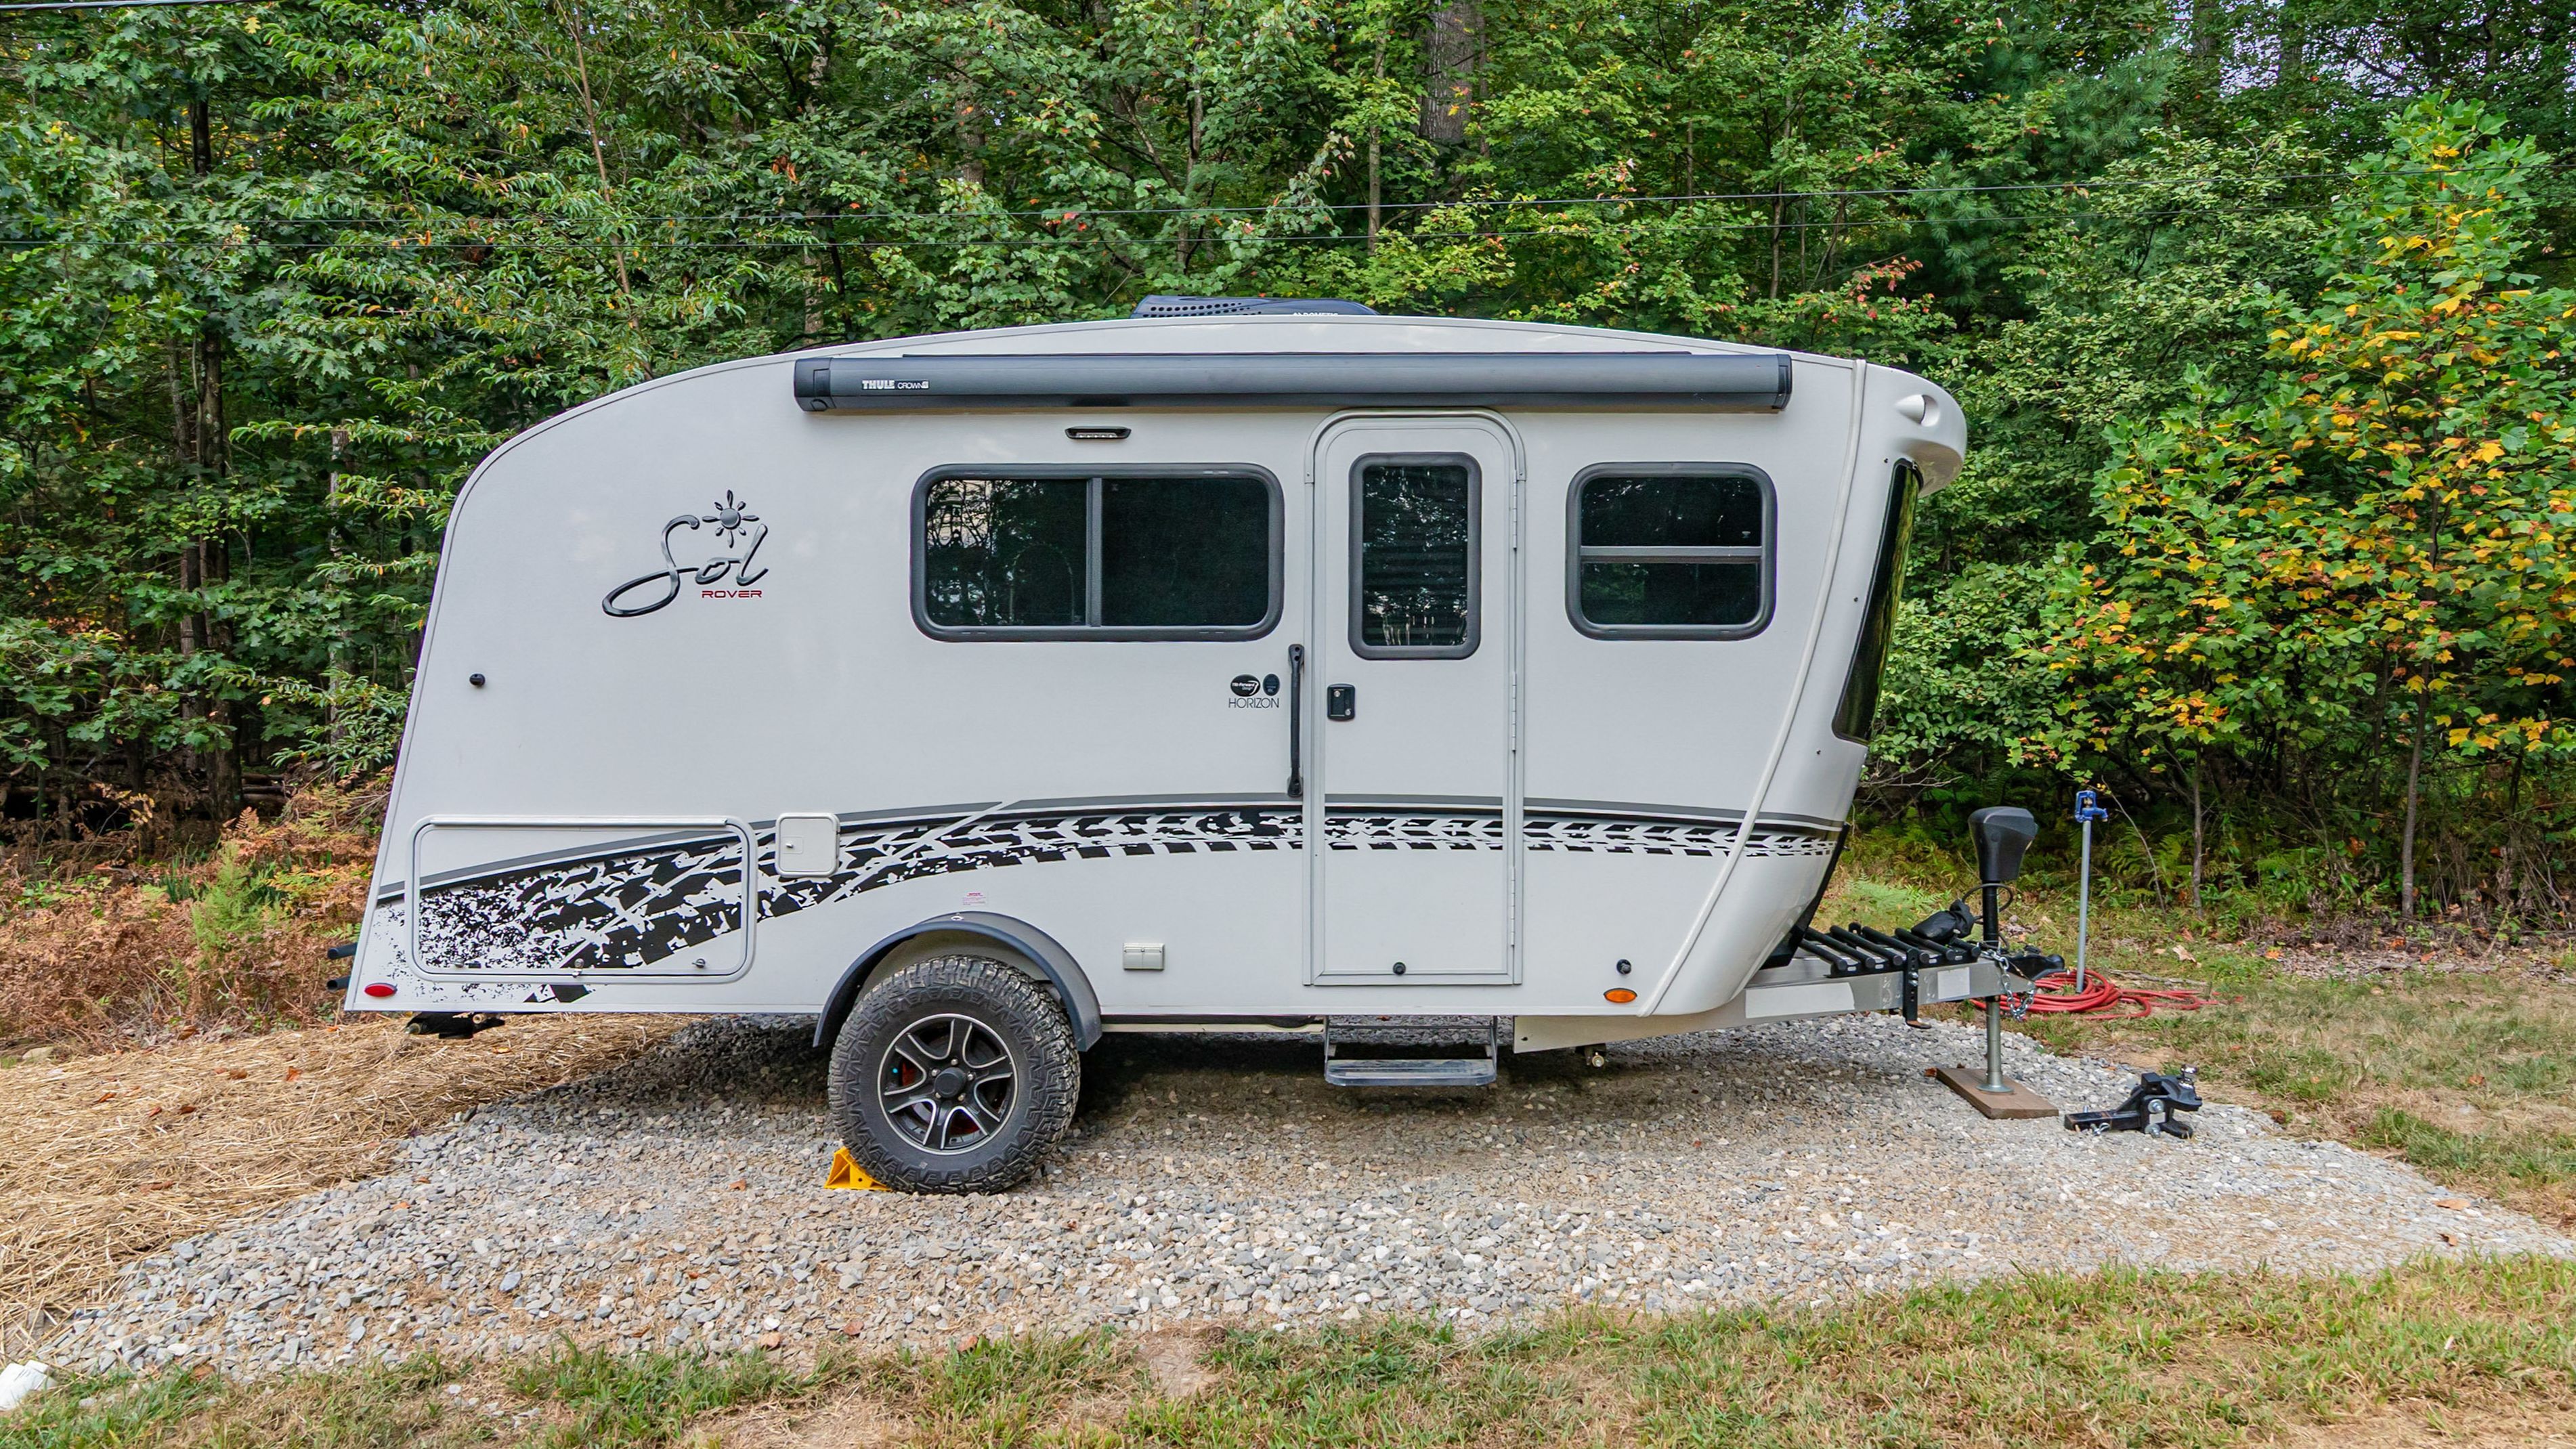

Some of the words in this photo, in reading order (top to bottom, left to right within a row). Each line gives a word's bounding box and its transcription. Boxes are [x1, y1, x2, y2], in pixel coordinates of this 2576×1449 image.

[862, 380, 895, 389] THULE
[602, 515, 769, 618] Sol
[1228, 697, 1279, 708] HORIZON
